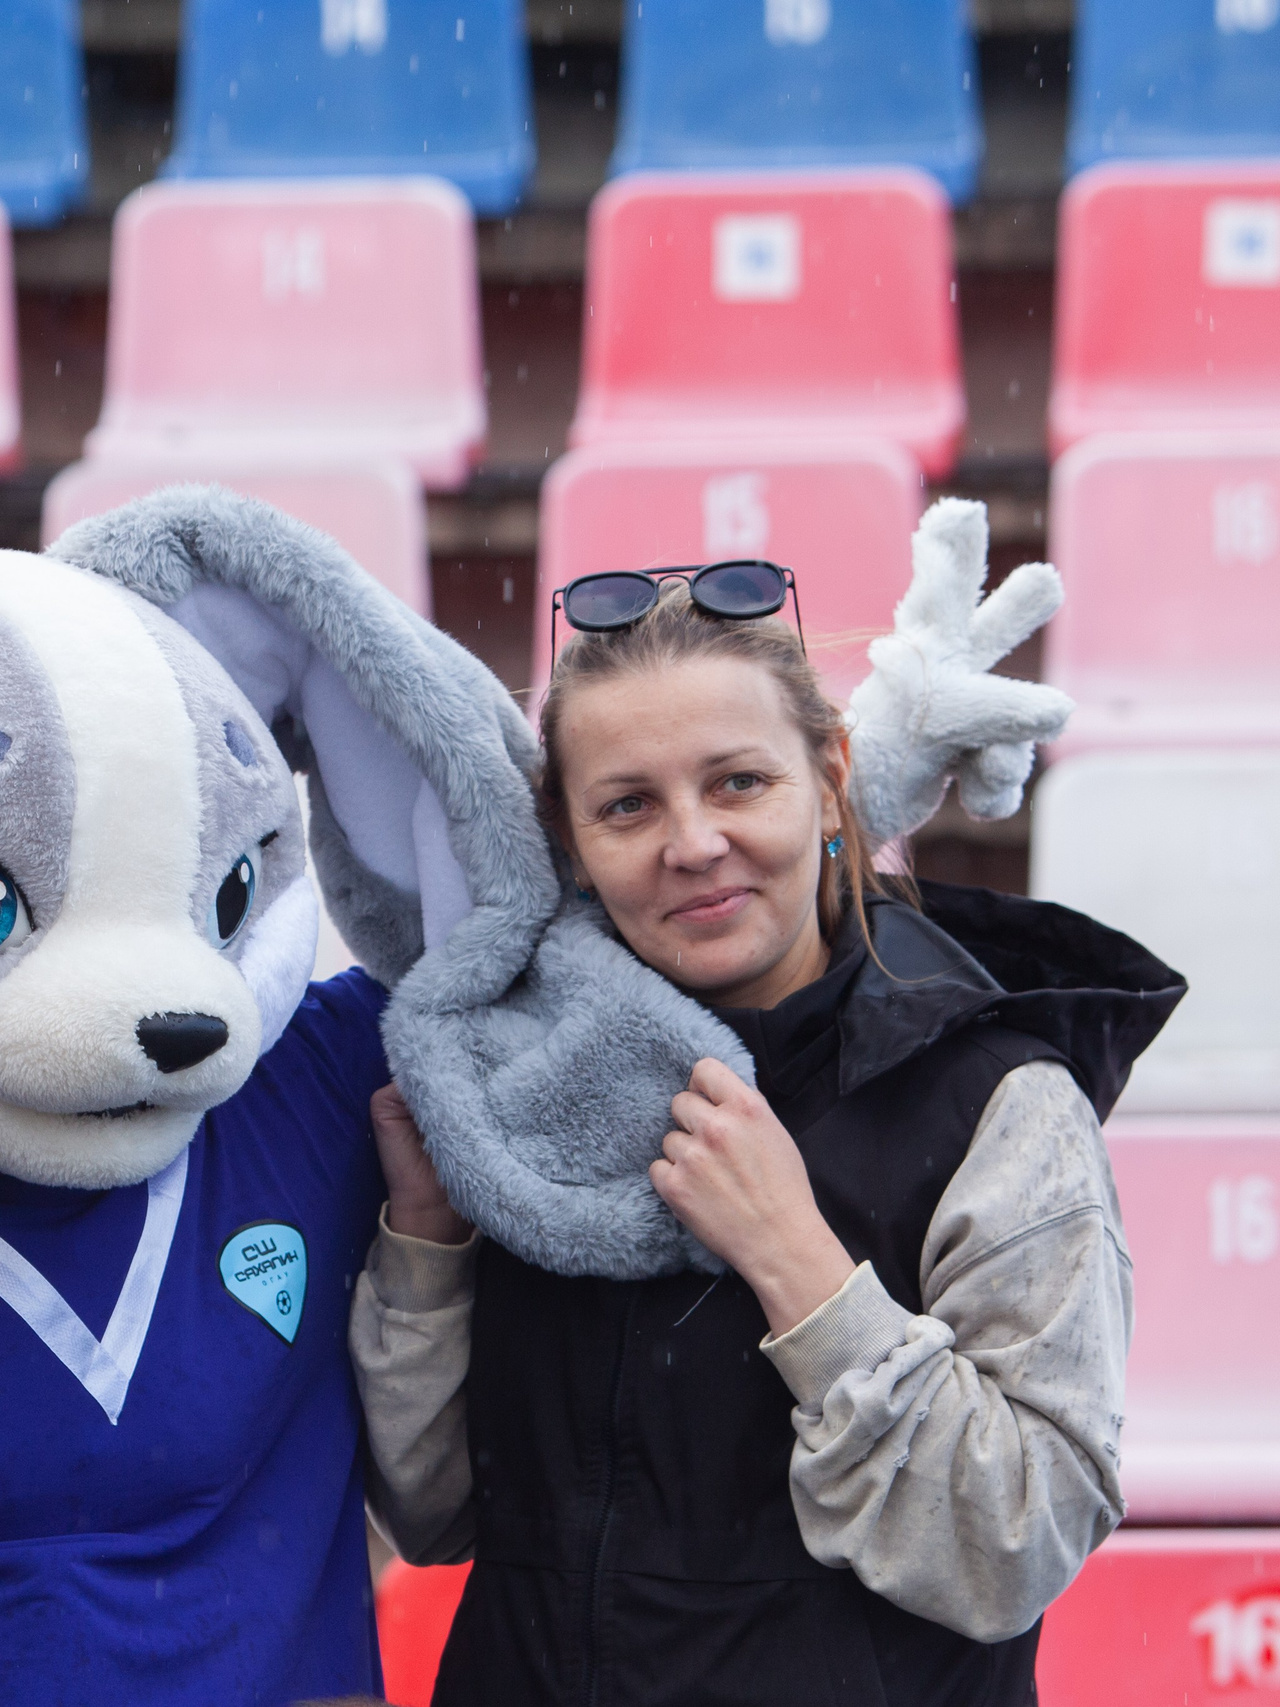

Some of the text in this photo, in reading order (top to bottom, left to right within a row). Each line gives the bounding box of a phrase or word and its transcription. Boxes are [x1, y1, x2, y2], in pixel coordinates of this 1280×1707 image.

[704, 472, 769, 557] 15
[1207, 1174, 1277, 1264] 16
[234, 1250, 299, 1282] САХАЛИН
[241, 1237, 277, 1262] СШ
